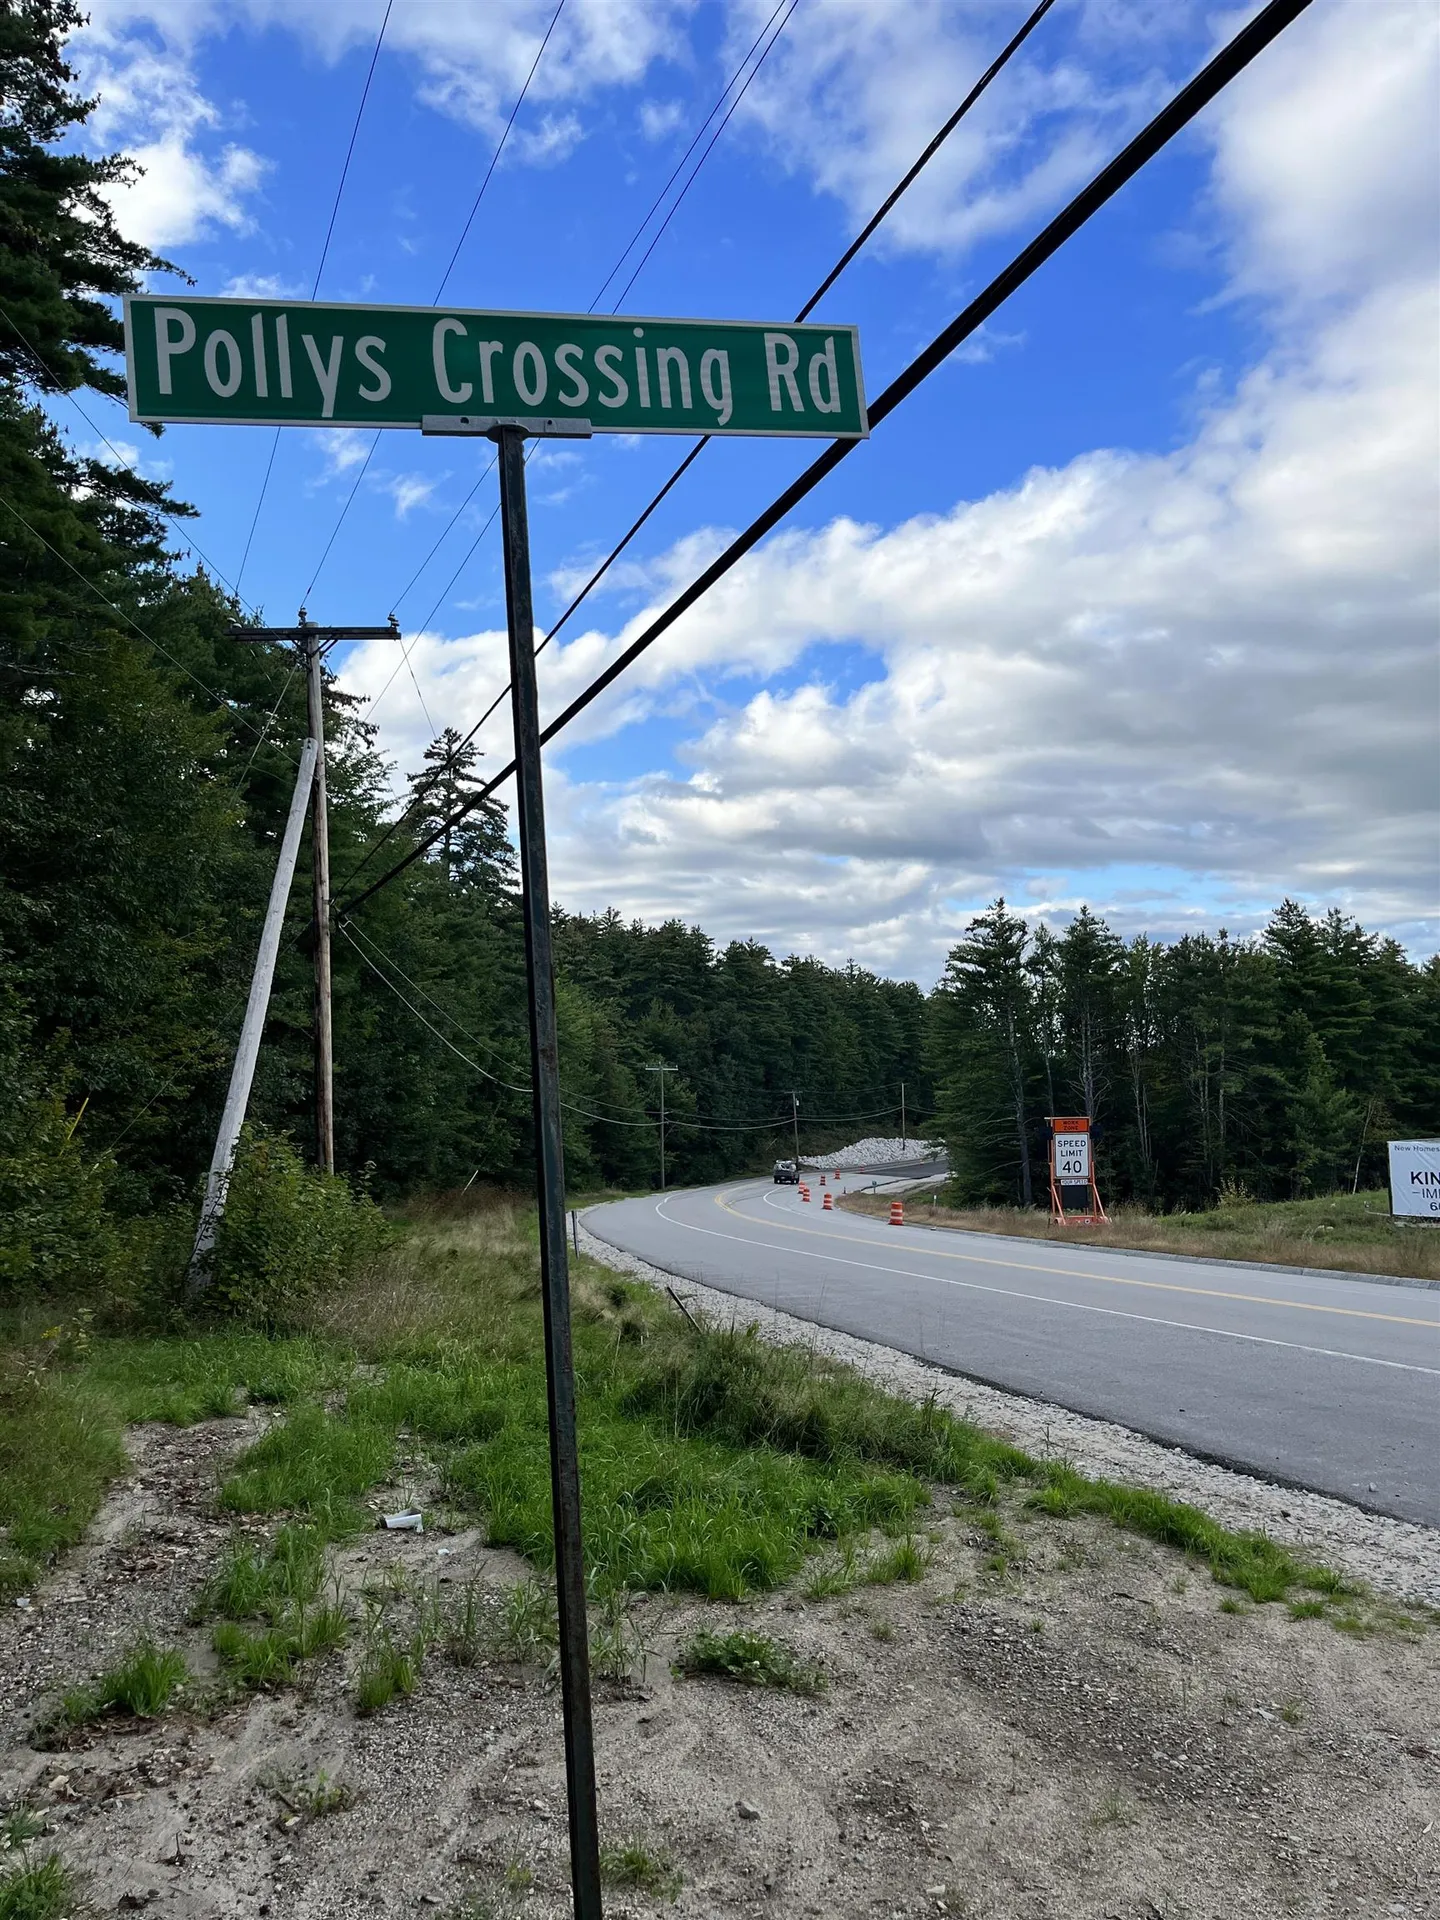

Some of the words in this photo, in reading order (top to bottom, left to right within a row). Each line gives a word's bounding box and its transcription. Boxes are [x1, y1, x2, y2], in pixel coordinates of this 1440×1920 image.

[155, 307, 391, 418] Pollys
[433, 318, 733, 426] Crossing
[765, 332, 842, 413] Rd
[1060, 1149, 1083, 1157] LIMIT
[1062, 1160, 1082, 1173] 40
[1422, 1188, 1440, 1198] IM
[1430, 1202, 1440, 1211] 6
